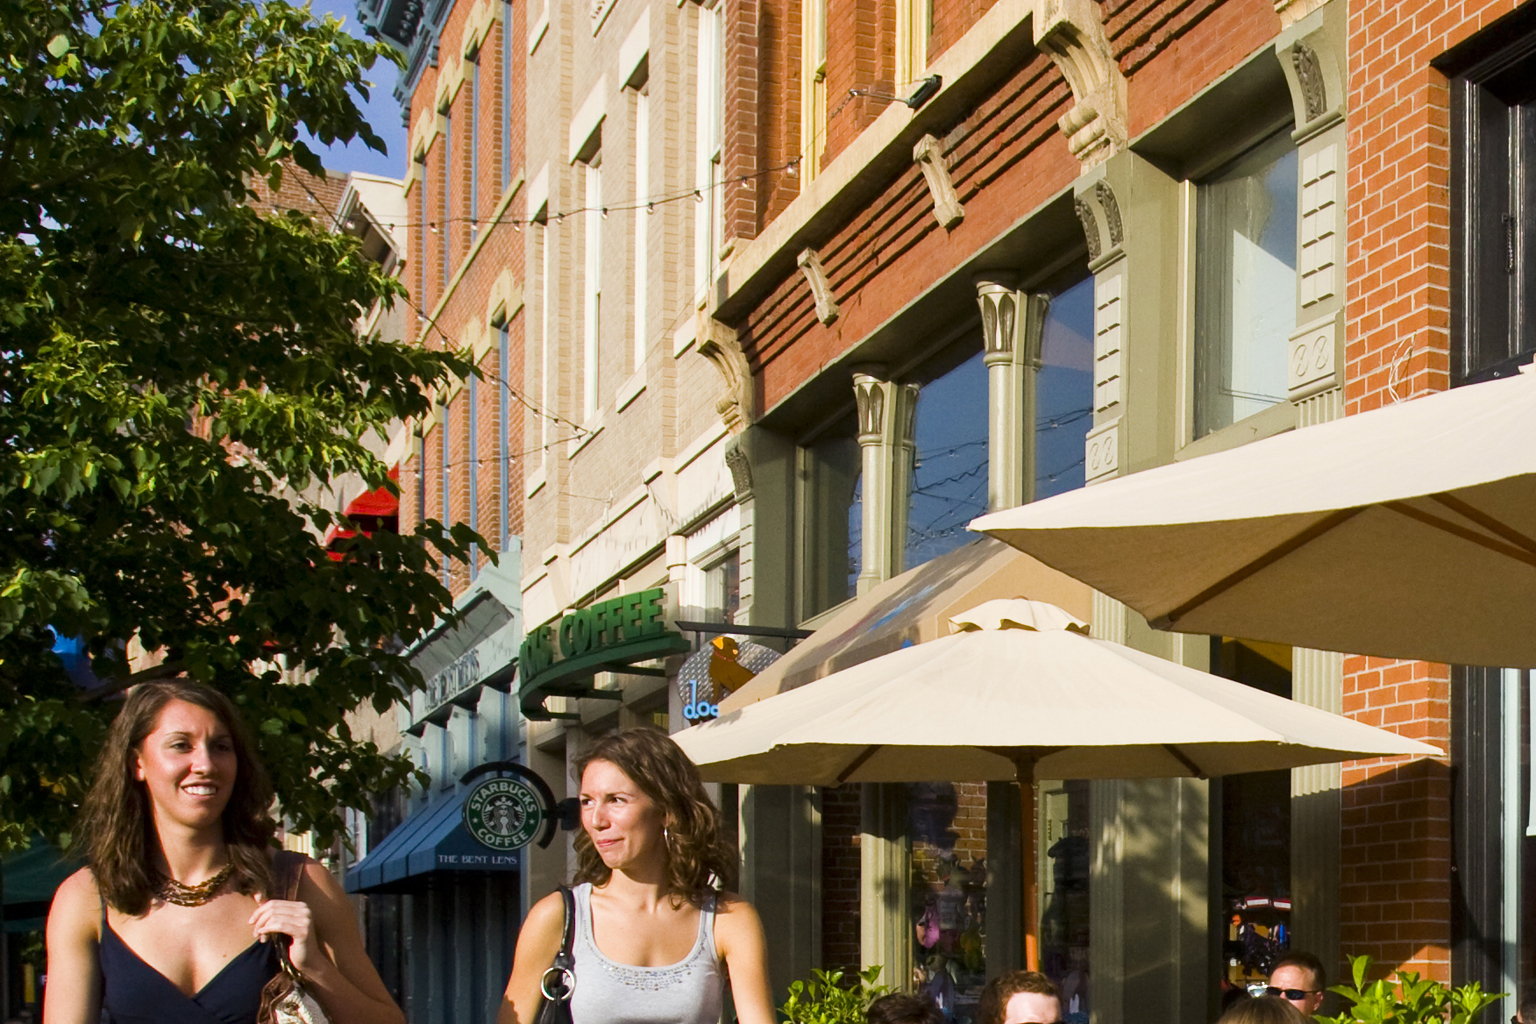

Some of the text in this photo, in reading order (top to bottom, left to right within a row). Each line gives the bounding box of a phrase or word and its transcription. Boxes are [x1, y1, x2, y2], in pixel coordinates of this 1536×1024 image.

[559, 587, 665, 659] COFFEE
[471, 781, 537, 813] STARBUCKS
[477, 828, 529, 847] COFFEE
[438, 854, 518, 865] THE BENT LENS
